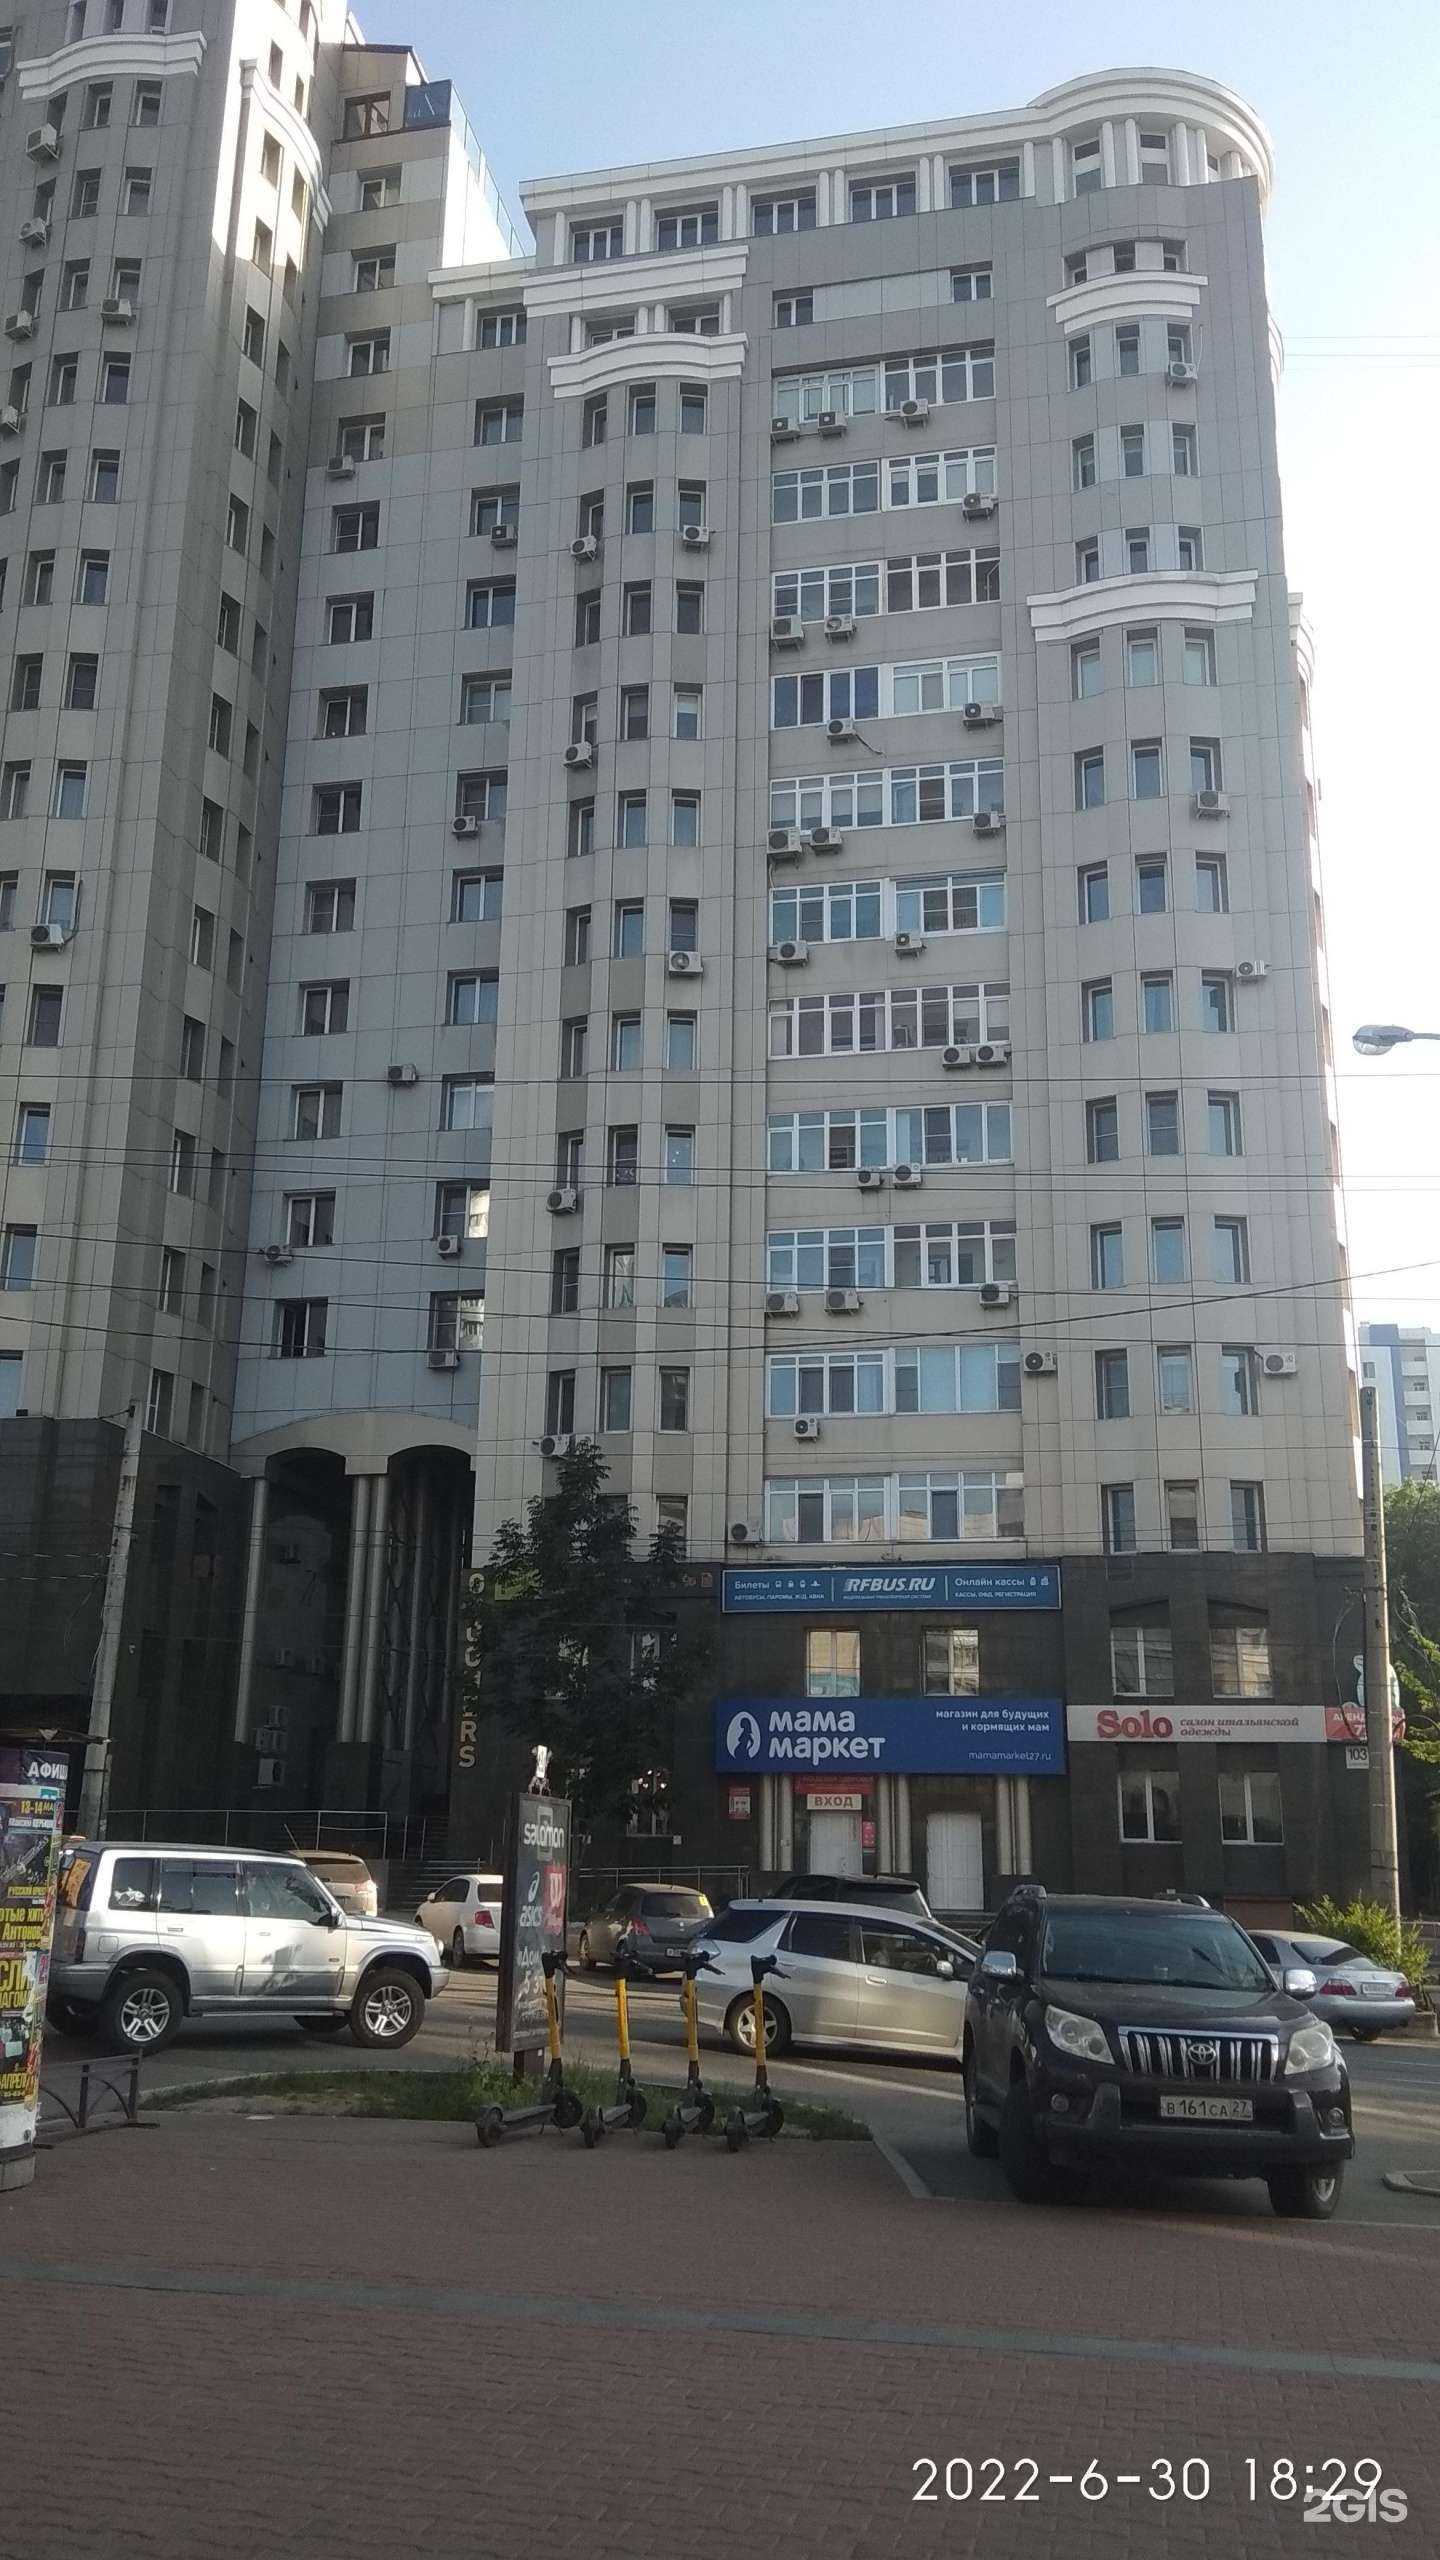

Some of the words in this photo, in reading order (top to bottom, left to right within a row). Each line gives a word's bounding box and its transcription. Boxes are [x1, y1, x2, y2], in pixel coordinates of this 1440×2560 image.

[735, 1580, 770, 1590] Билеты
[844, 1577, 936, 1592] RFBUS.RU
[954, 1577, 993, 1587] Онлайн
[994, 1578, 1025, 1587] кассы
[769, 1710, 856, 1732] мама
[936, 1710, 978, 1719] магазин
[980, 1710, 1000, 1720] для
[1002, 1708, 1049, 1721] будущих
[961, 1723, 969, 1732] и
[971, 1723, 1026, 1733] кормящих
[1028, 1723, 1050, 1732] мам
[1096, 1709, 1174, 1739] Solo
[1180, 1718, 1215, 1727] салон
[1217, 1716, 1300, 1727] итальянской
[1180, 1727, 1232, 1737] одежды
[769, 1736, 886, 1767] маркет
[968, 1750, 1052, 1761] mamamarket27.ru
[1349, 1747, 1368, 1761] 103
[814, 1796, 854, 1809] ВХОД
[523, 1821, 565, 1849] salomon
[519, 1904, 544, 1928] asics
